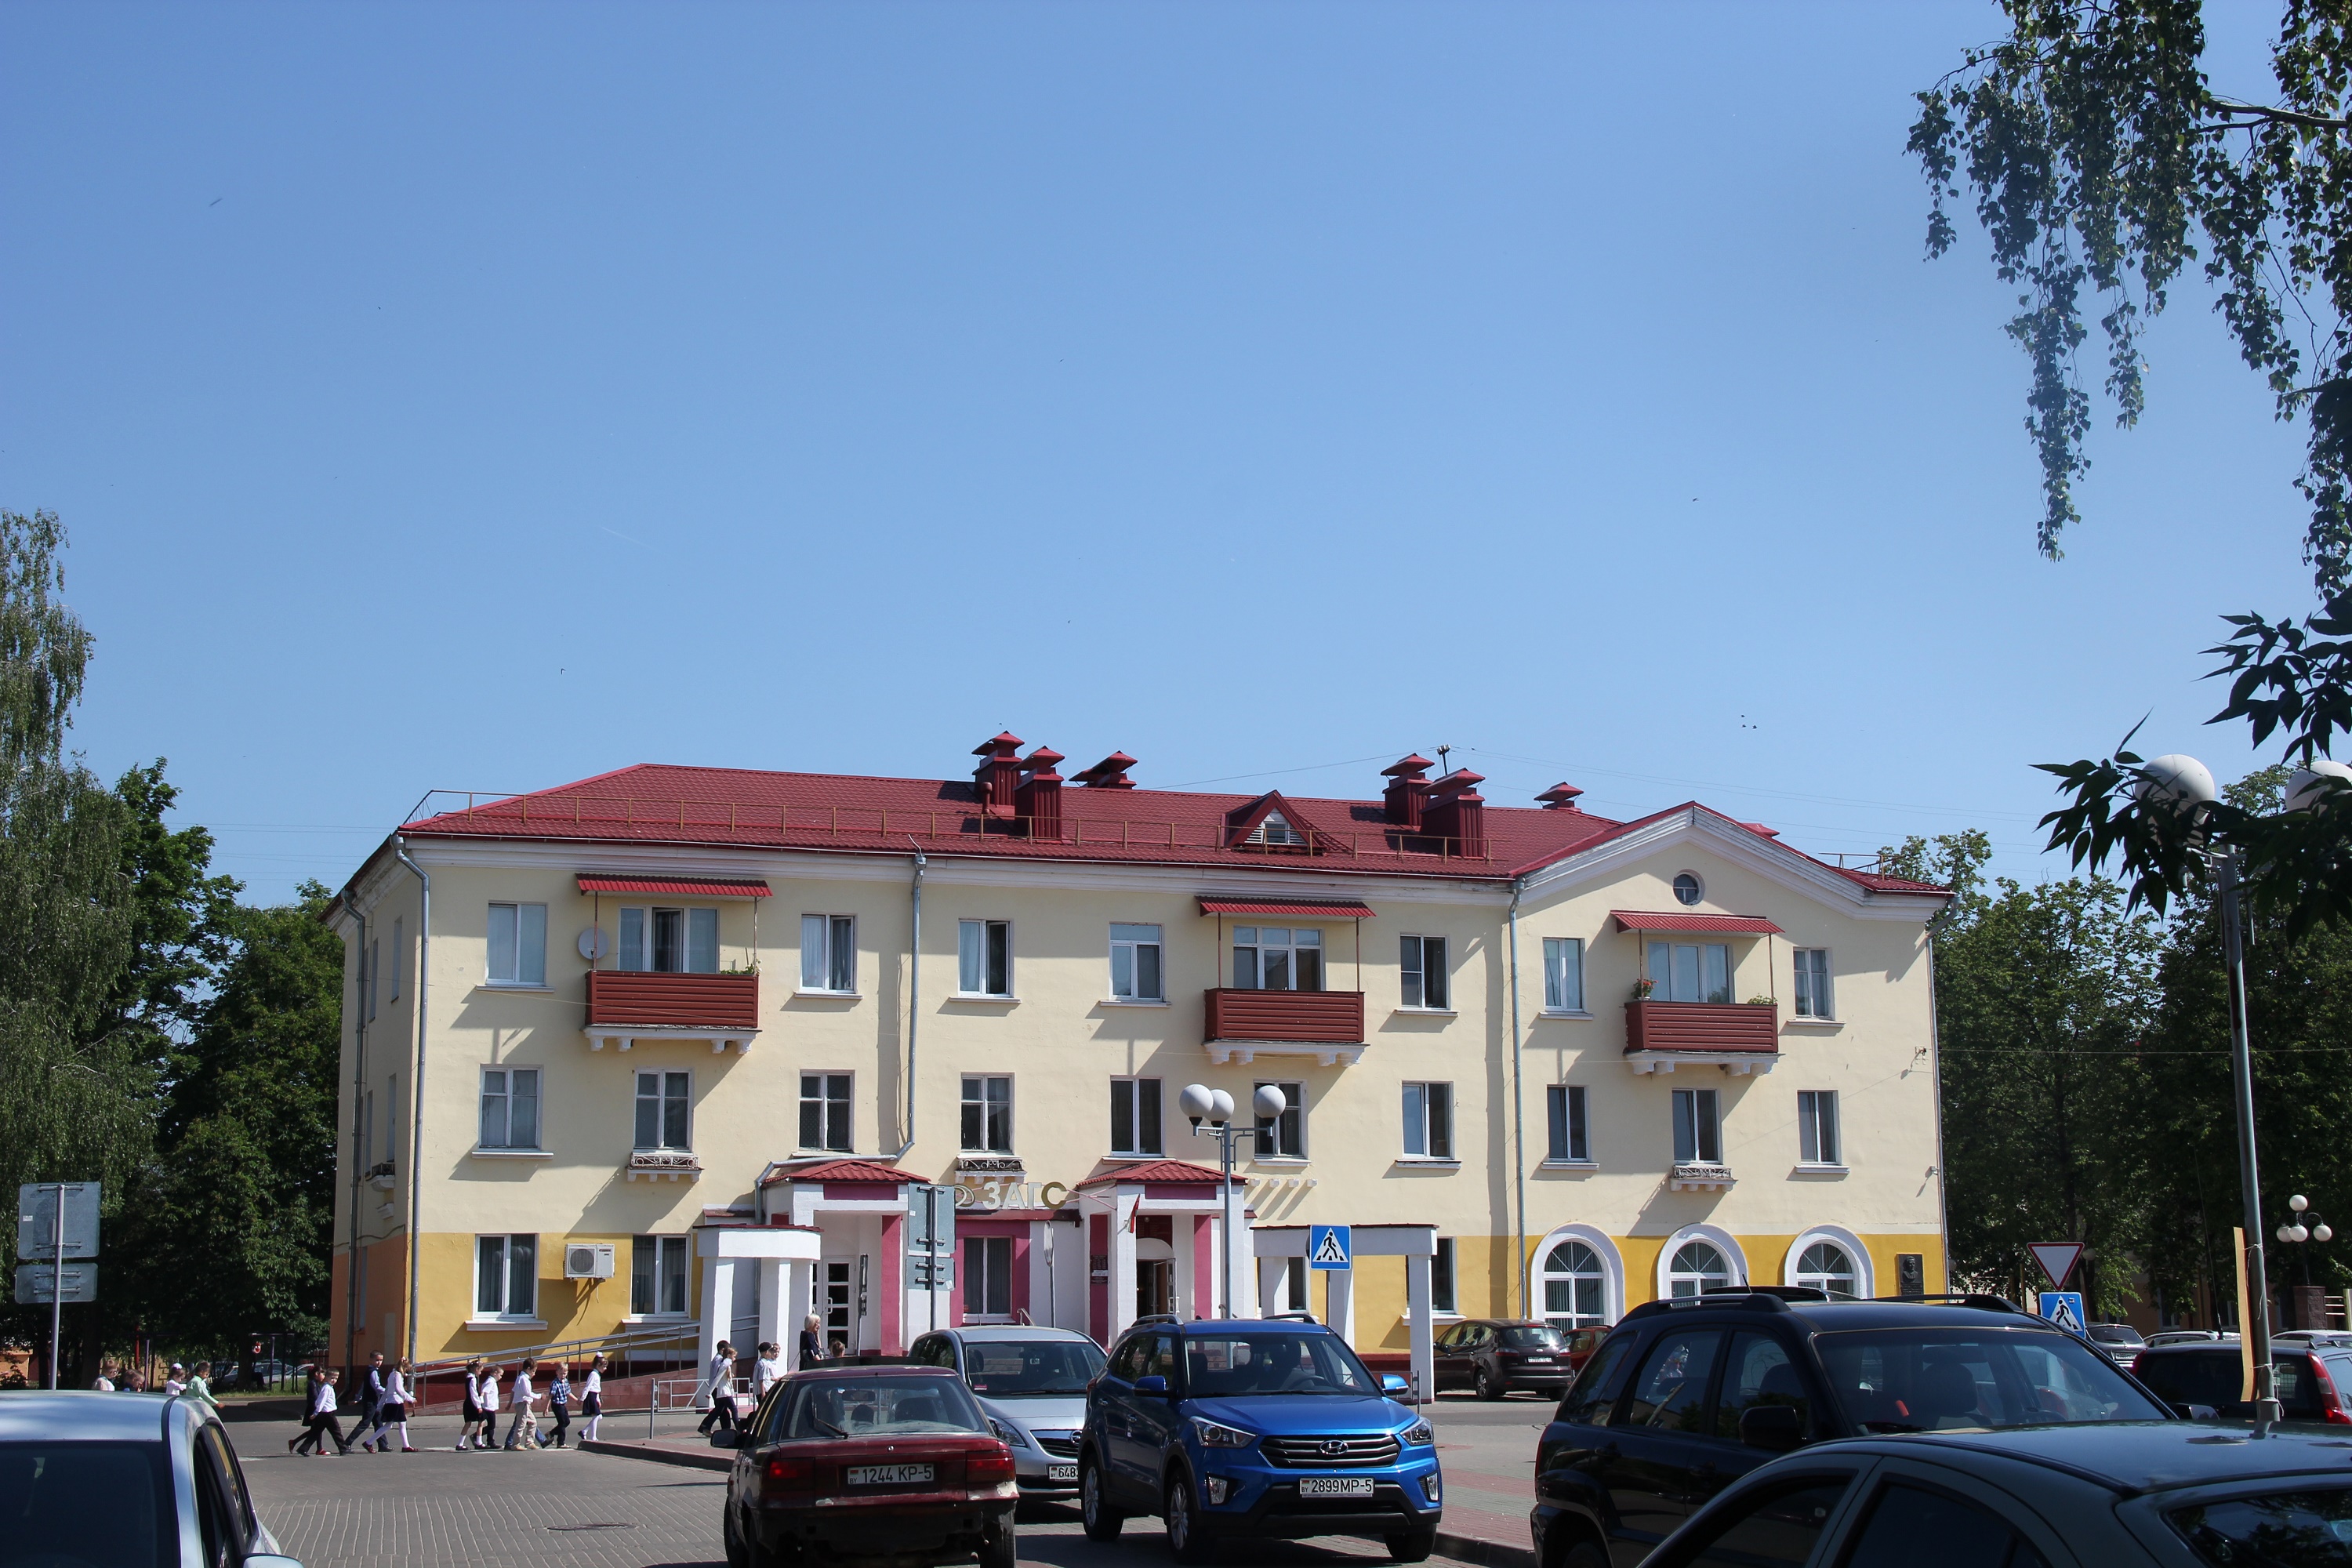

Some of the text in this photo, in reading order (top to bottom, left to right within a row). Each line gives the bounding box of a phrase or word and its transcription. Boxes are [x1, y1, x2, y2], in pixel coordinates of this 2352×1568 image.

[982, 1181, 1067, 1210] ЗАГС
[862, 1465, 932, 1483] 1244 KP-5
